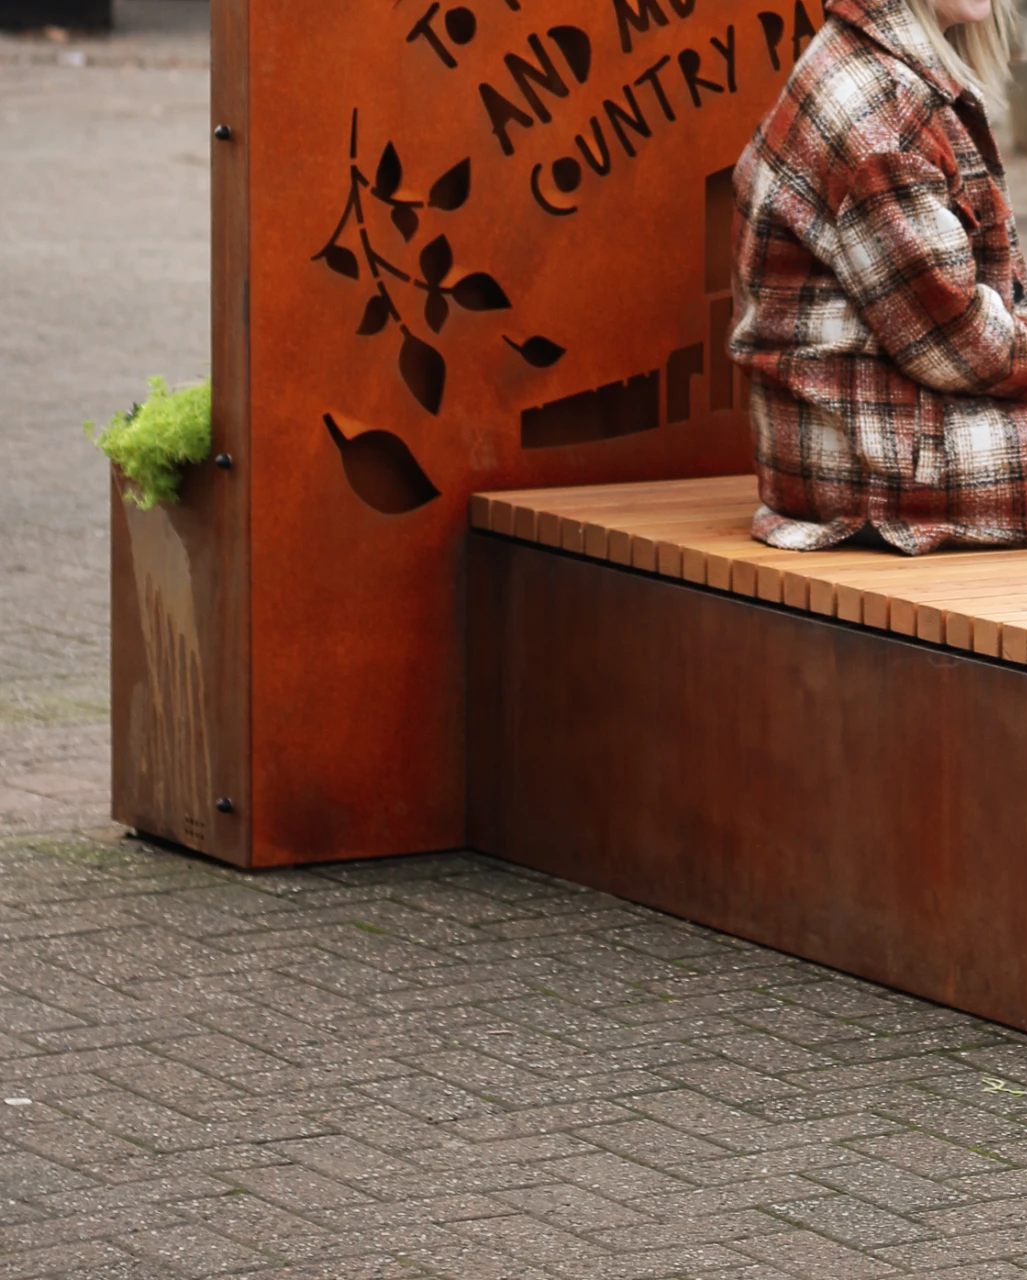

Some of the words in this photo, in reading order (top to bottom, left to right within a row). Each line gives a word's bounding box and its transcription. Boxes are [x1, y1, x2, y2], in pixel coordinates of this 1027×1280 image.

[406, 2, 477, 69] TO
[478, 25, 592, 156] AND
[530, 24, 737, 216] COUNTRY
